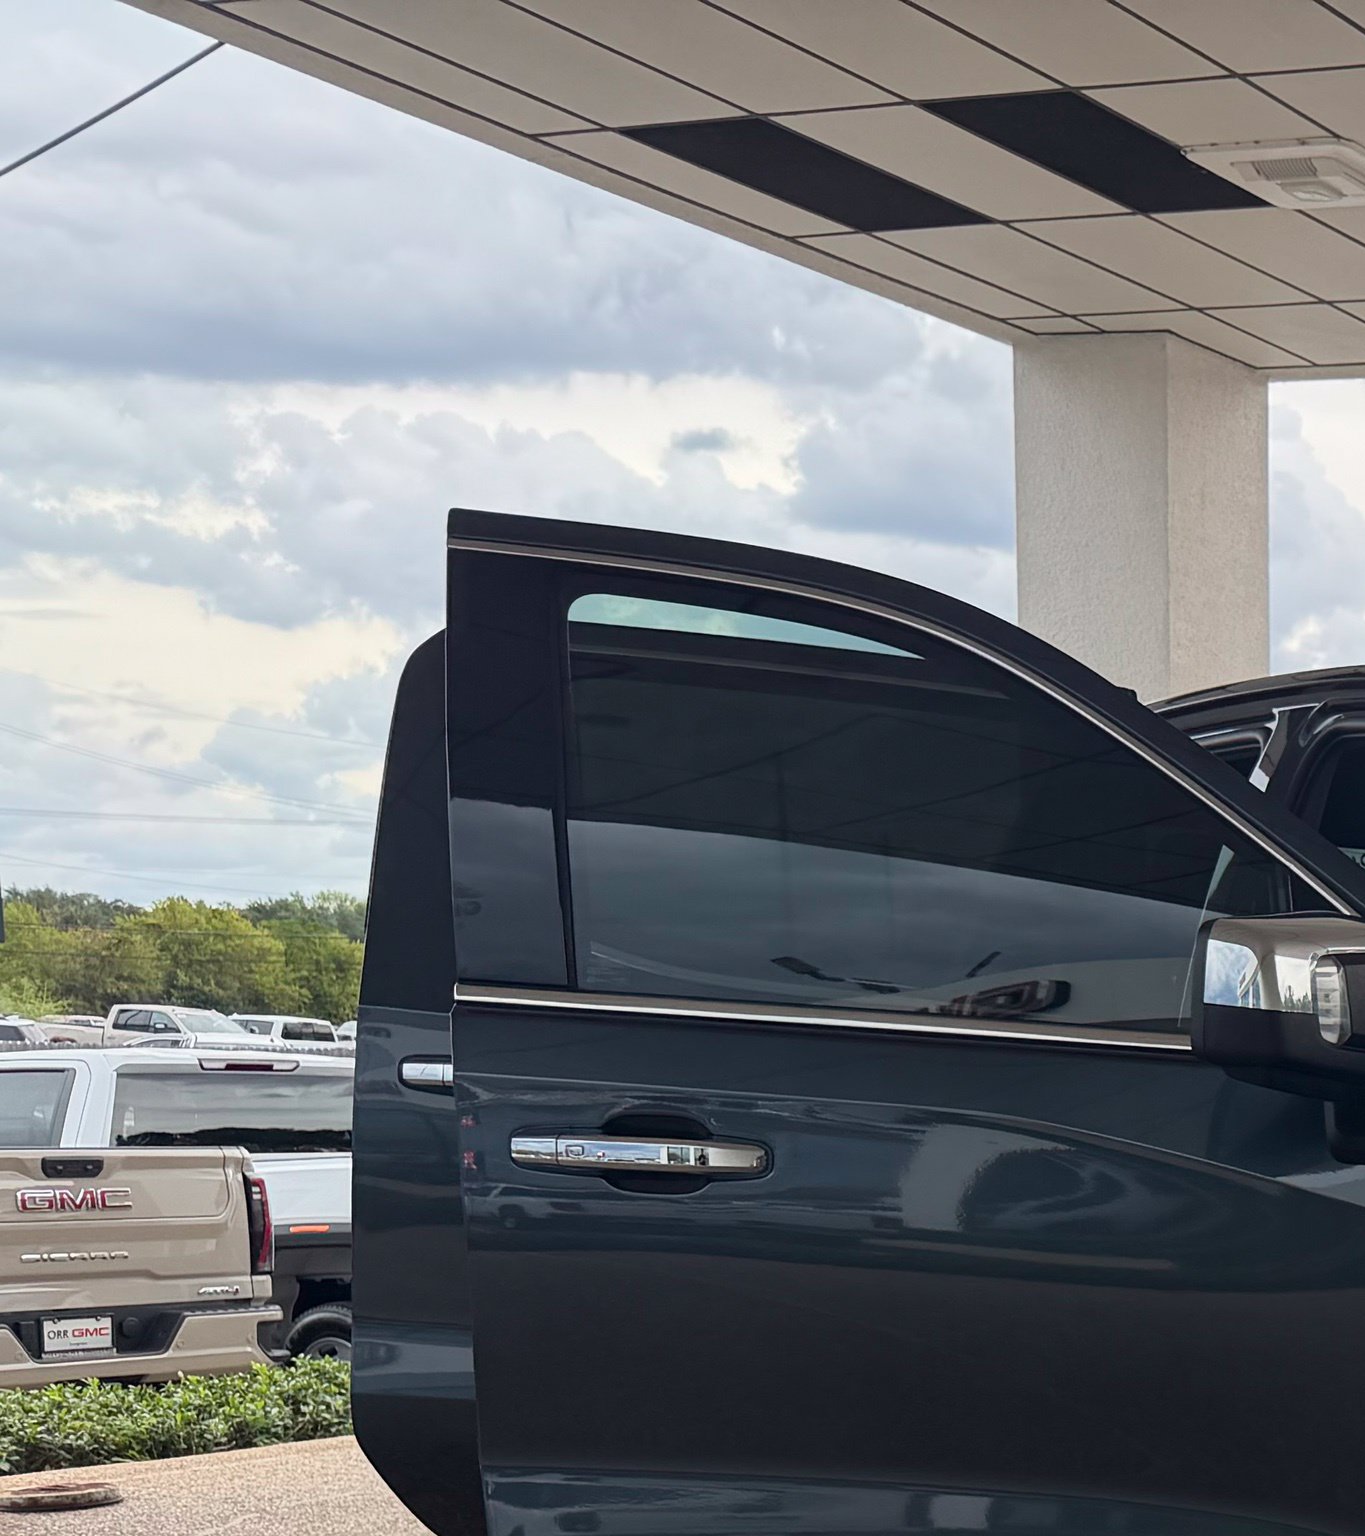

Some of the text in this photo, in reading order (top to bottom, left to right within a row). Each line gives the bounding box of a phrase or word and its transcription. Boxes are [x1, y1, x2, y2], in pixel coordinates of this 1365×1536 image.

[16, 1187, 133, 1213] GMC
[47, 1326, 110, 1341] ORR GMC
